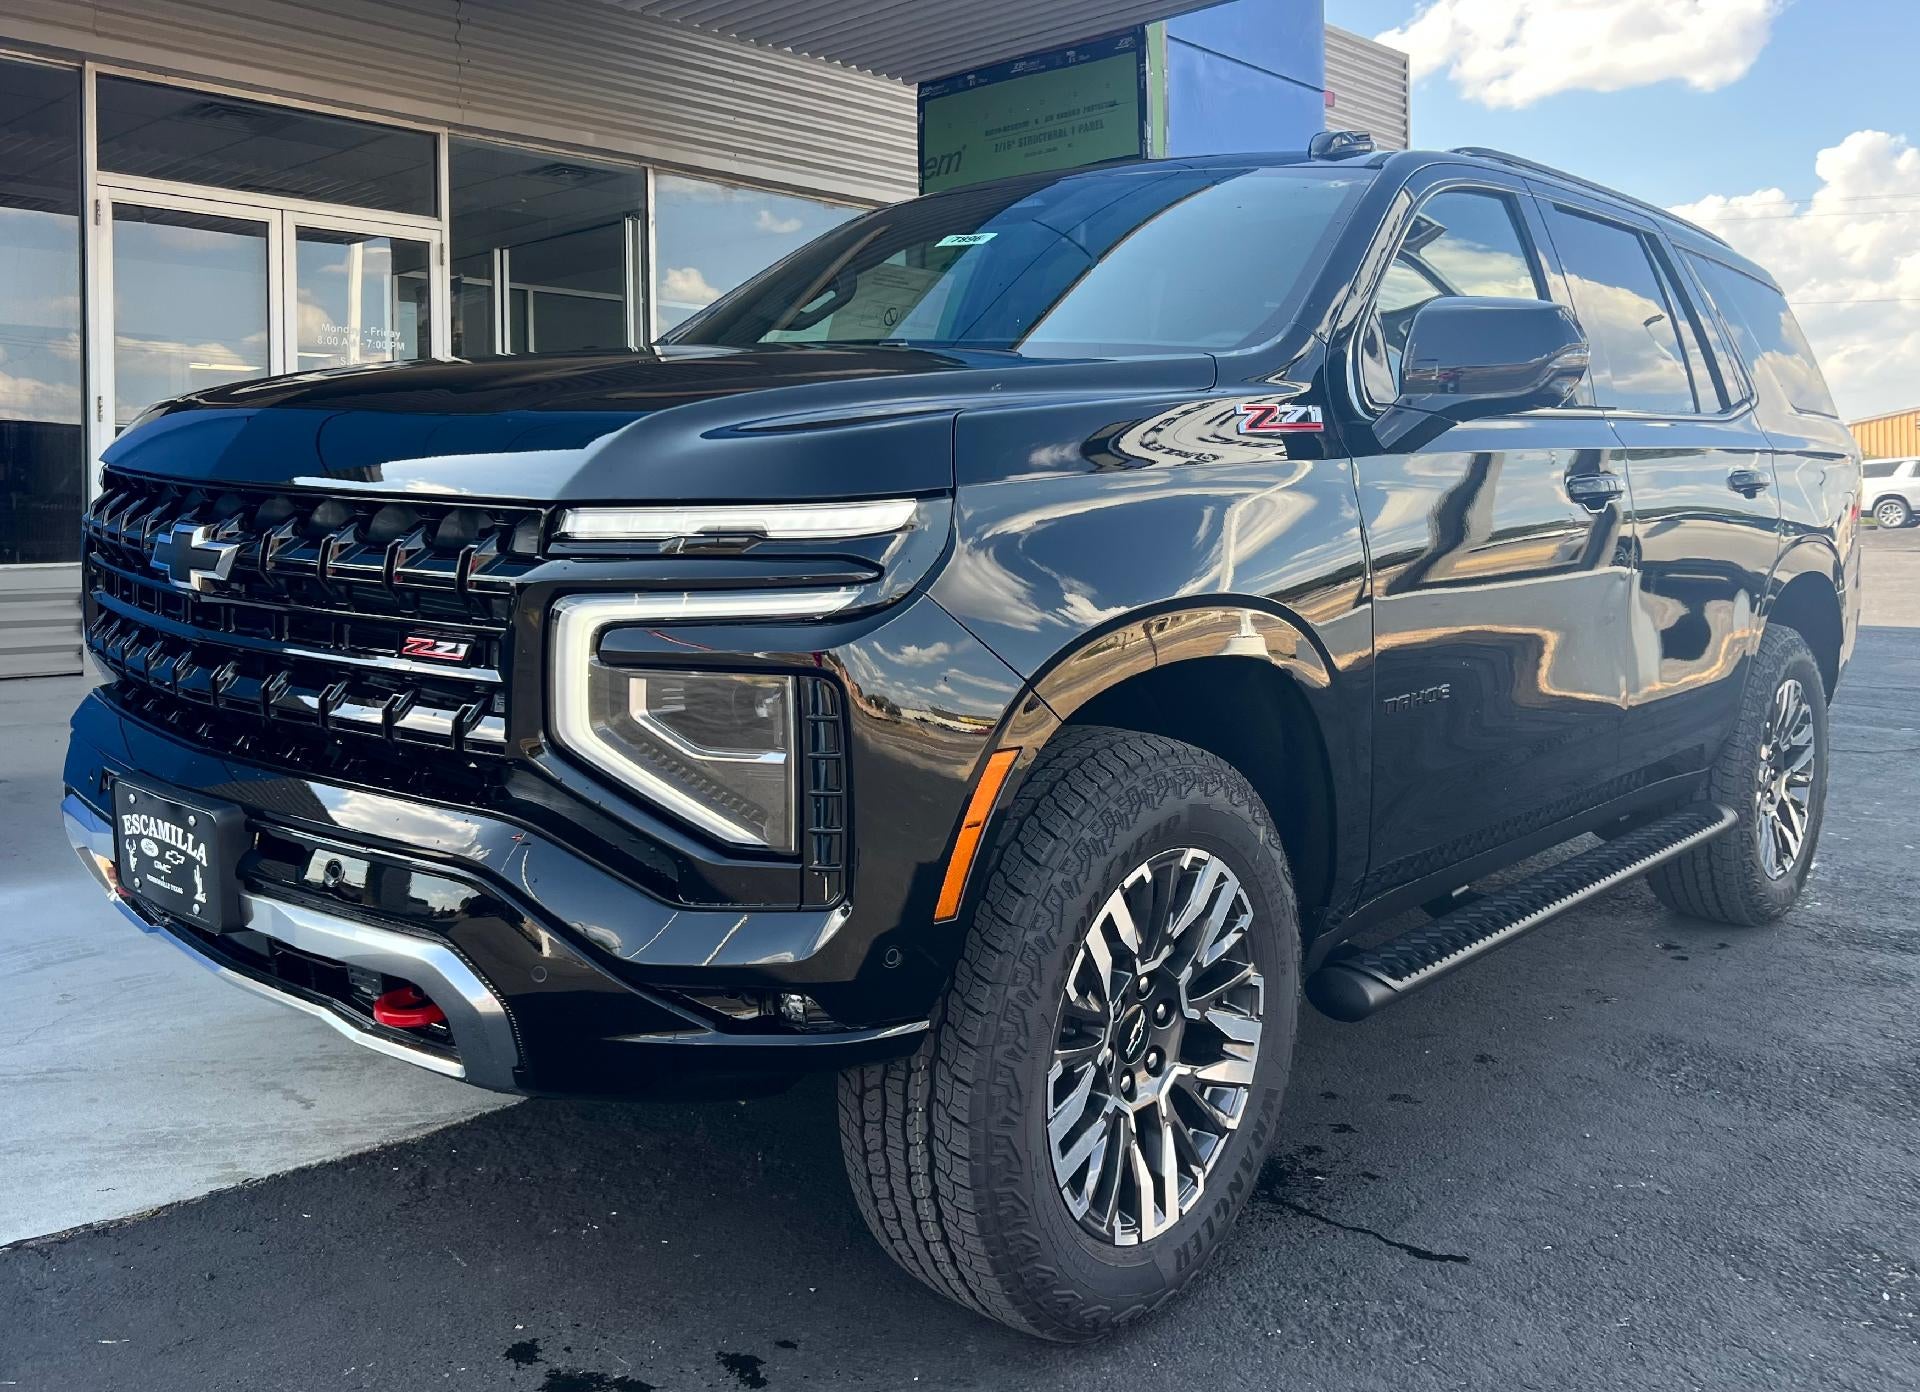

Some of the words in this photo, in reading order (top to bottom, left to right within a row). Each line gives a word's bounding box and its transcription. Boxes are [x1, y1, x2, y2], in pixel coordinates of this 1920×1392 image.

[317, 335, 339, 346] 8:00
[366, 339, 387, 350] 7:00
[390, 340, 405, 352] PM
[321, 323, 360, 338] Mond
[370, 327, 401, 340] Friday
[1234, 403, 1324, 435] Z71
[402, 636, 470, 661] Z71
[1384, 683, 1451, 714] TAHOE
[121, 813, 208, 868] ESCAMILLA
[153, 859, 172, 874] GMC
